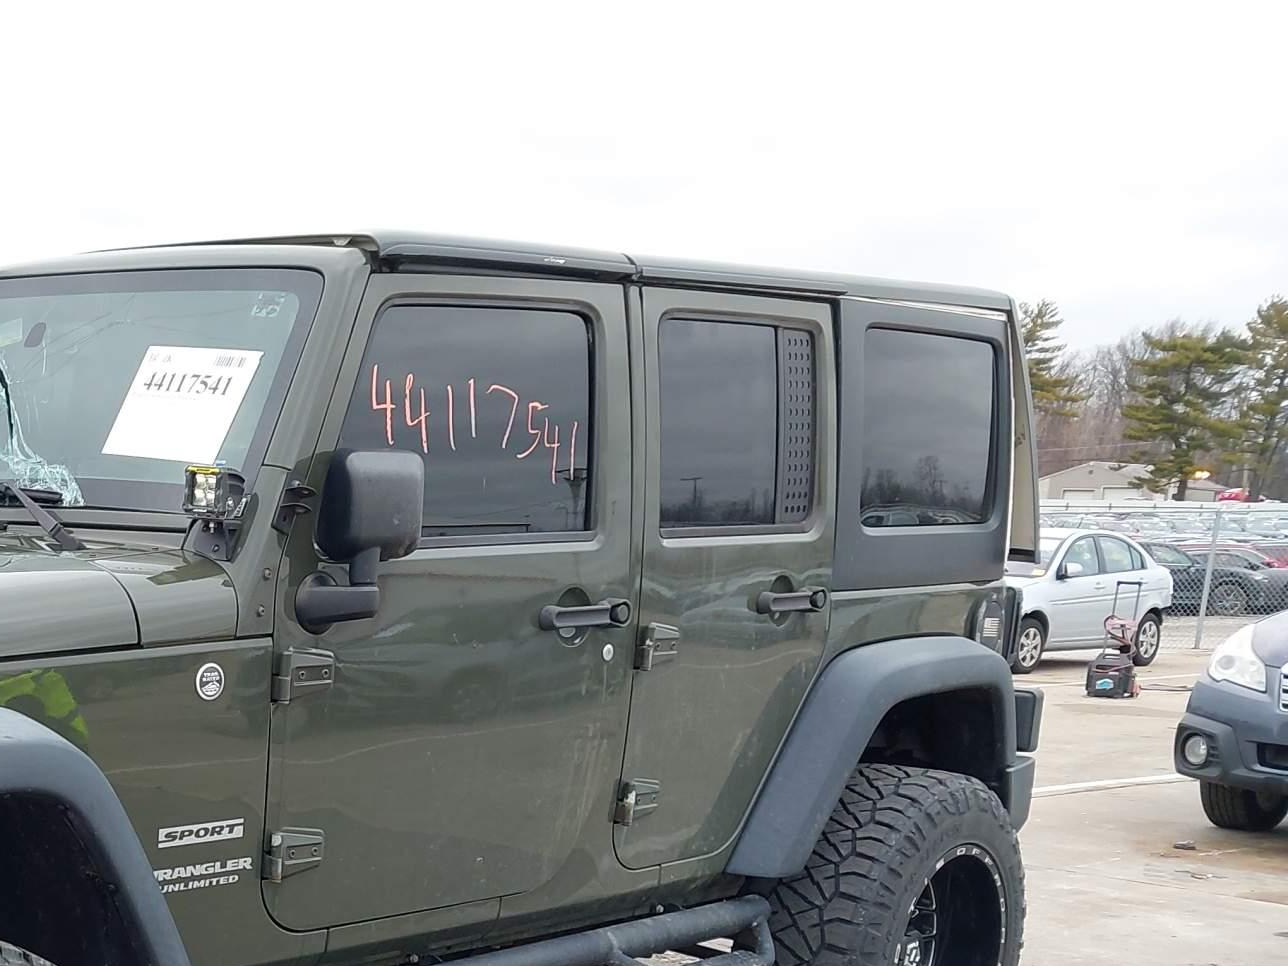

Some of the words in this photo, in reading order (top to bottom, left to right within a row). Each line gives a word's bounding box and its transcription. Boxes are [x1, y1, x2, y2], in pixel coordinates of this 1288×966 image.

[143, 371, 233, 396] 44117541
[371, 363, 579, 485] 44117541
[163, 823, 237, 842] SPORT
